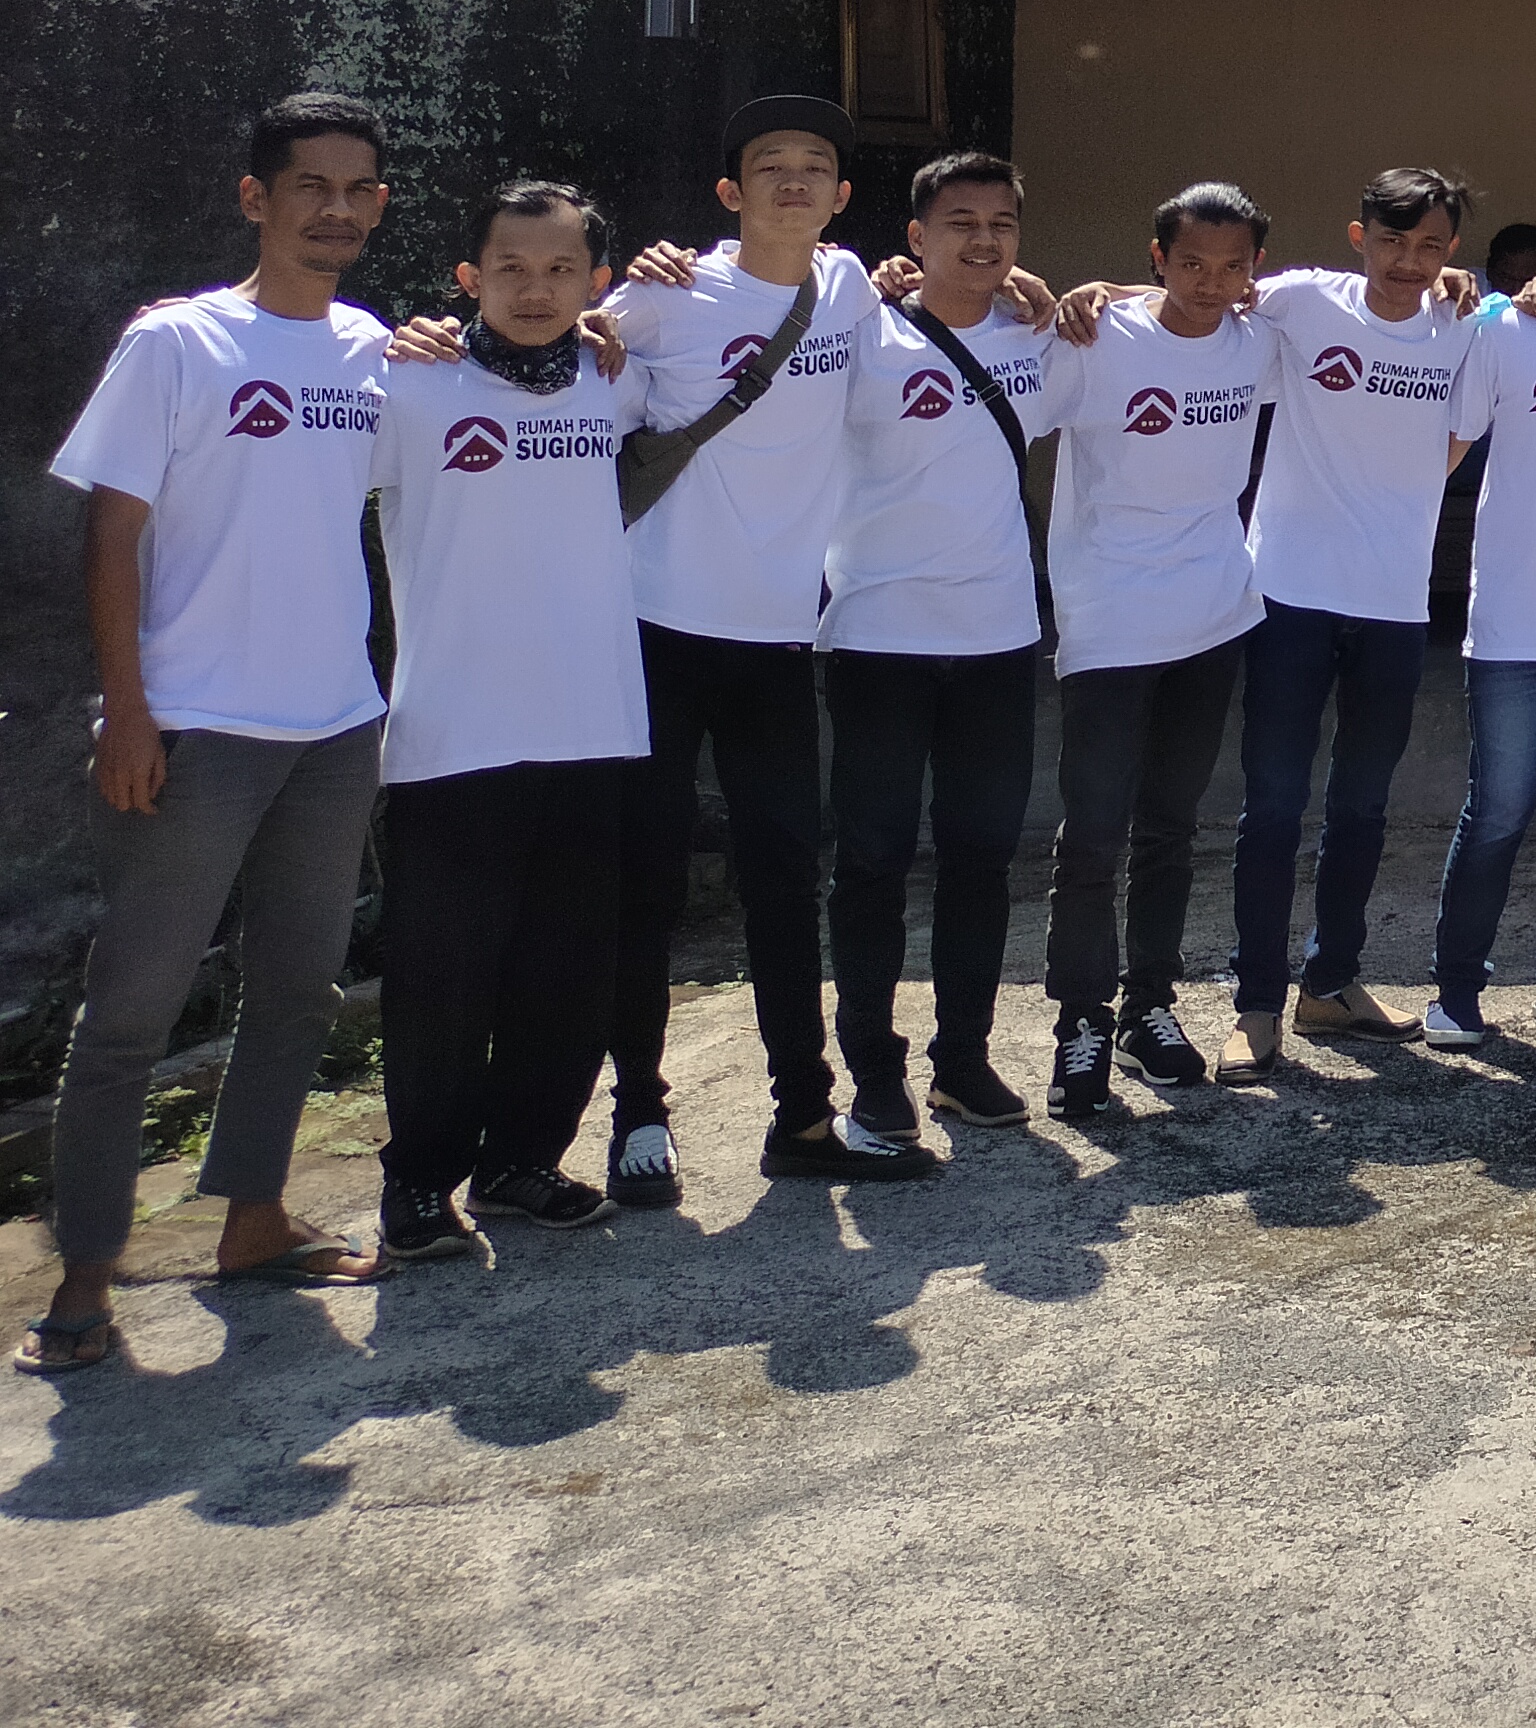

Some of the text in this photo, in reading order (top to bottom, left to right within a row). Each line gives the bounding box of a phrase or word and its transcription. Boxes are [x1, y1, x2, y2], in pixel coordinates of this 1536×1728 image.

[1371, 361, 1451, 381] RUMAH PUTIH
[301, 387, 354, 403] RUMAH
[1185, 389, 1230, 404] RUMAH
[1366, 376, 1449, 402] SUGIONO
[517, 419, 574, 435] RUMAH
[516, 435, 614, 461] SUGIONO
